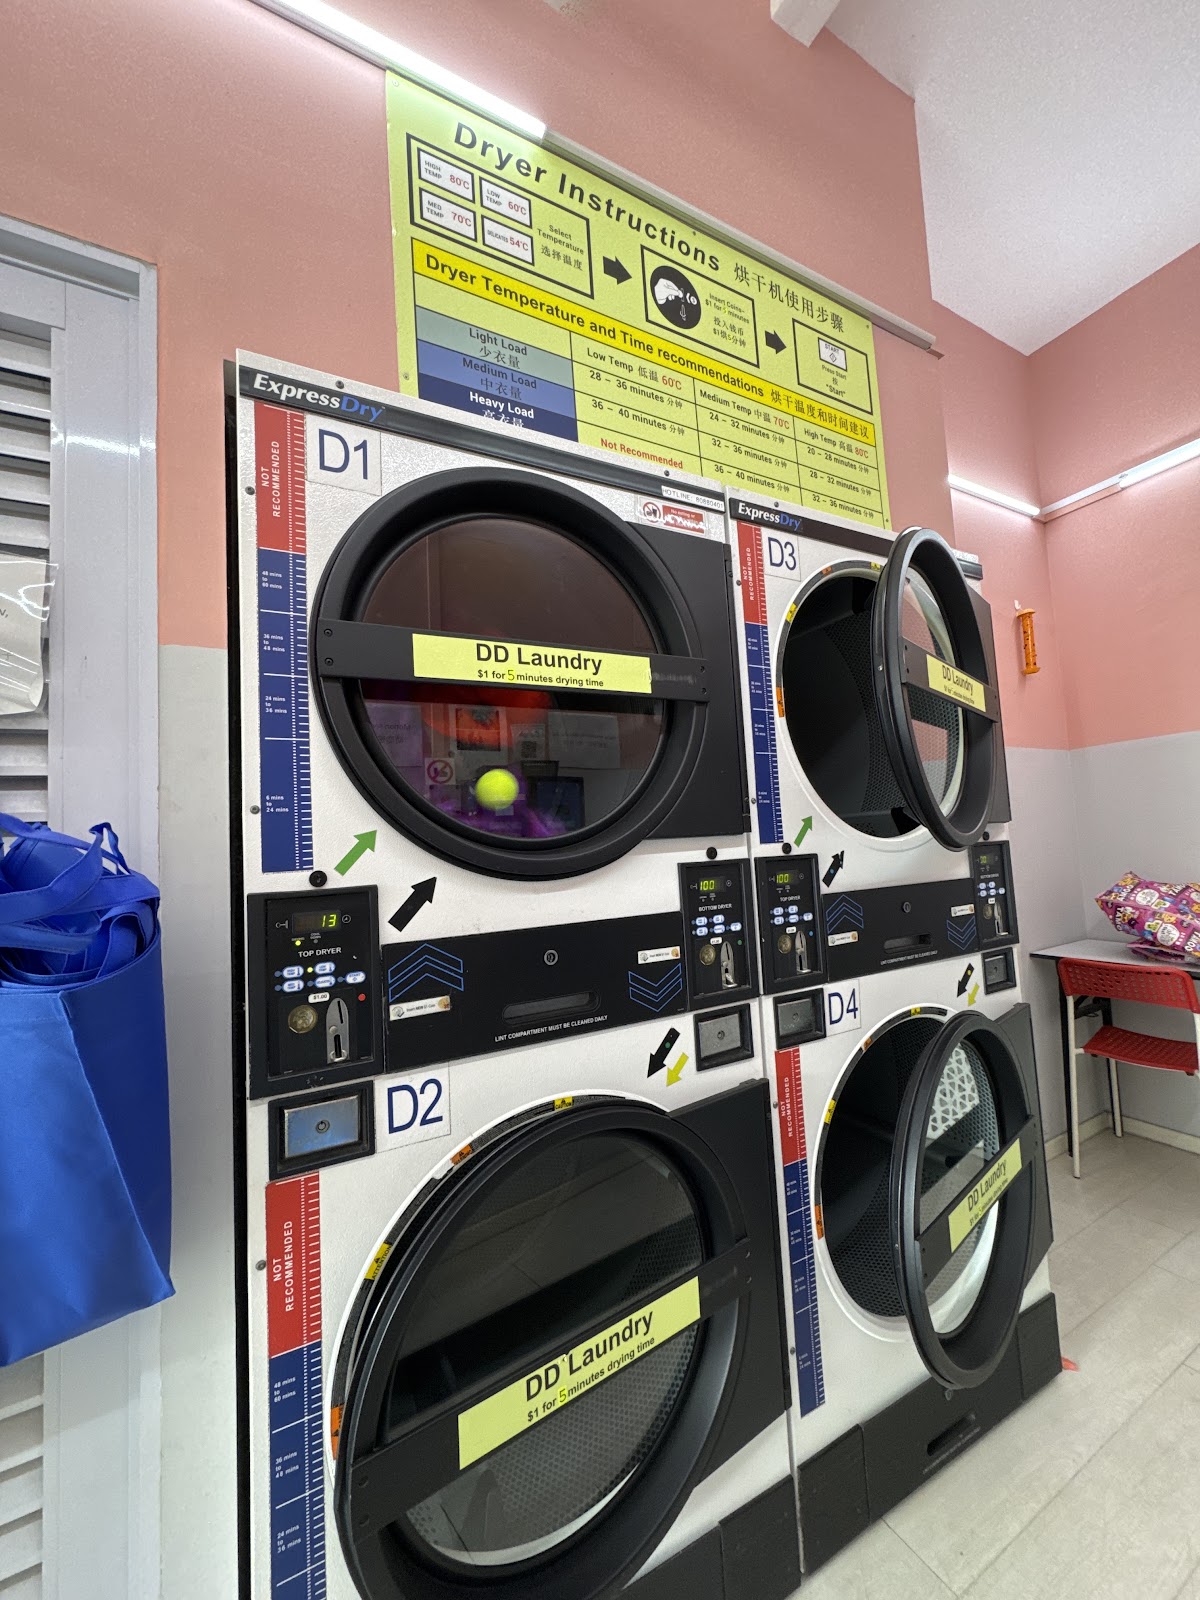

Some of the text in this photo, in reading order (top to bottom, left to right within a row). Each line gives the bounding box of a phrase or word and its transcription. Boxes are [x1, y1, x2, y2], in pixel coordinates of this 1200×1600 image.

[424, 160, 441, 172] HIGH
[424, 168, 442, 179] TEMP
[427, 200, 442, 211] MED
[486, 188, 501, 200] LOW
[486, 195, 503, 206] TEMP
[426, 207, 444, 218] TEMP
[454, 122, 845, 334] Dryer Instructions 烘干机使用步骤
[548, 224, 572, 241] Select
[537, 229, 584, 255] Temperature
[540, 245, 584, 272] 选择温度
[705, 298, 712, 307] $1
[713, 302, 722, 311] for
[727, 310, 750, 324] minutes
[709, 292, 726, 306] Insert
[426, 254, 869, 439] Dryer Temperature and Time recommendations 烘干温度和时间建议
[469, 327, 528, 356] Light Load
[824, 343, 840, 353] START
[478, 345, 521, 370] 少衣量
[587, 347, 606, 361] Low
[608, 355, 634, 373] Temp
[638, 366, 659, 382] 低温
[462, 357, 537, 389] Medium Load
[821, 364, 847, 380] Press Start
[253, 373, 383, 423] ExpressDry
[480, 377, 522, 401] 中衣量
[589, 370, 683, 409] 28 36 minutes 分钟
[469, 391, 535, 419] Heavy Load
[591, 399, 685, 437] 36 40 minutes 分钟
[699, 389, 730, 407] Medium
[732, 400, 752, 416] Temp
[754, 409, 772, 423] 中温
[709, 412, 785, 445] 24 32 minutes 分钟
[804, 428, 819, 441] High
[820, 434, 837, 447] Temp
[838, 440, 853, 453] 高温
[318, 428, 368, 480] D1
[600, 438, 684, 469] Not Recommended
[711, 438, 787, 469] 32 36 minutes 分钟
[833, 456, 857, 472] minutes
[260, 466, 270, 488] NOT
[271, 441, 281, 518] RECOMMENDED
[714, 464, 790, 493] 36 40 minutes 分钟
[809, 470, 818, 480] 28
[826, 475, 835, 485] 32
[836, 479, 860, 494] minutes
[663, 488, 693, 502] HOTLINE:
[812, 493, 821, 503] 32
[829, 499, 838, 509] 36
[838, 501, 862, 517] minutes
[738, 502, 801, 531] ExpressDry
[767, 536, 797, 571] D3
[745, 547, 754, 601] RECOMMENDED
[475, 642, 603, 676] DD Laundry
[477, 668, 604, 687] $1 for 5 minutes drying time
[941, 664, 951, 682] DD
[952, 670, 974, 696] Laundry
[700, 880, 715, 891] 100
[321, 914, 337, 928] 13
[698, 904, 718, 912] BOTTOM
[298, 946, 342, 958] TOP DRYER
[827, 988, 859, 1025] D4
[494, 1034, 507, 1043] LINT
[507, 1026, 548, 1040] COMPARTMENT
[548, 1023, 563, 1032] MUST
[570, 1017, 594, 1027] CLEANED
[594, 1014, 608, 1023] DAILY
[387, 1078, 443, 1135] D2
[784, 1077, 793, 1138] RECOMMENDED
[967, 1189, 979, 1212] DD
[979, 1159, 1007, 1195] Laundry
[273, 1258, 282, 1282] NOT
[283, 1220, 295, 1312] RECOMMENDED
[371, 1246, 392, 1280] ATTENTION
[525, 1311, 654, 1402] DD Laundry
[273, 1375, 296, 1389] 48 mins
[527, 1336, 655, 1423] $1 for 5 minutes drying time
[273, 1389, 281, 1397] to
[273, 1389, 297, 1403] 60 mins
[275, 1450, 298, 1465] 36 mins
[275, 1464, 282, 1472] to
[275, 1464, 299, 1479] 48 mins
[277, 1524, 300, 1539] 24 mins
[277, 1537, 302, 1554] 36 mins
